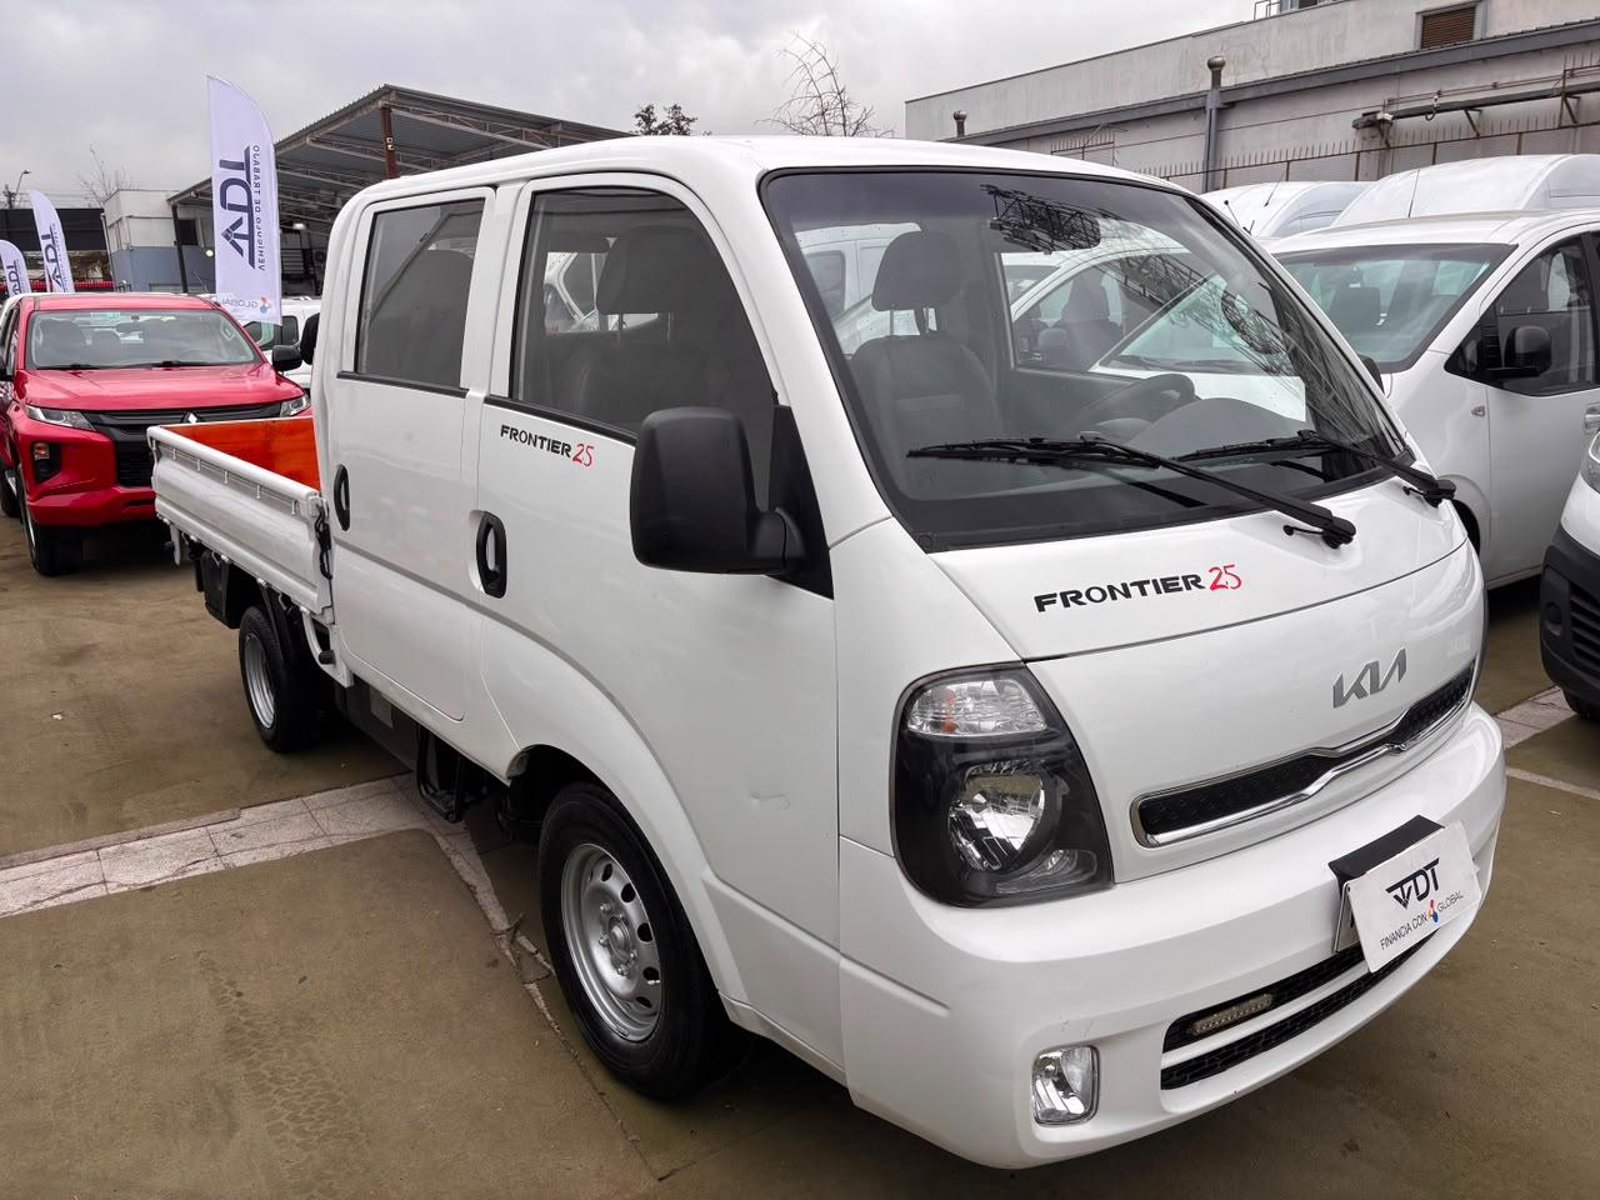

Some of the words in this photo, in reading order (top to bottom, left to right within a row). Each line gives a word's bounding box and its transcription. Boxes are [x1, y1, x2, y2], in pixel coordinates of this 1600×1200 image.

[500, 424, 572, 458] FRONTIER
[572, 443, 595, 467] 25
[1034, 574, 1206, 612] FRONTIER
[1208, 564, 1242, 591] 25
[1332, 647, 1407, 708] KIA
[1385, 857, 1440, 910] VDT
[1379, 921, 1413, 950] FINANCIA
[1412, 912, 1428, 930] CON
[1437, 891, 1464, 912] GLOBAL
